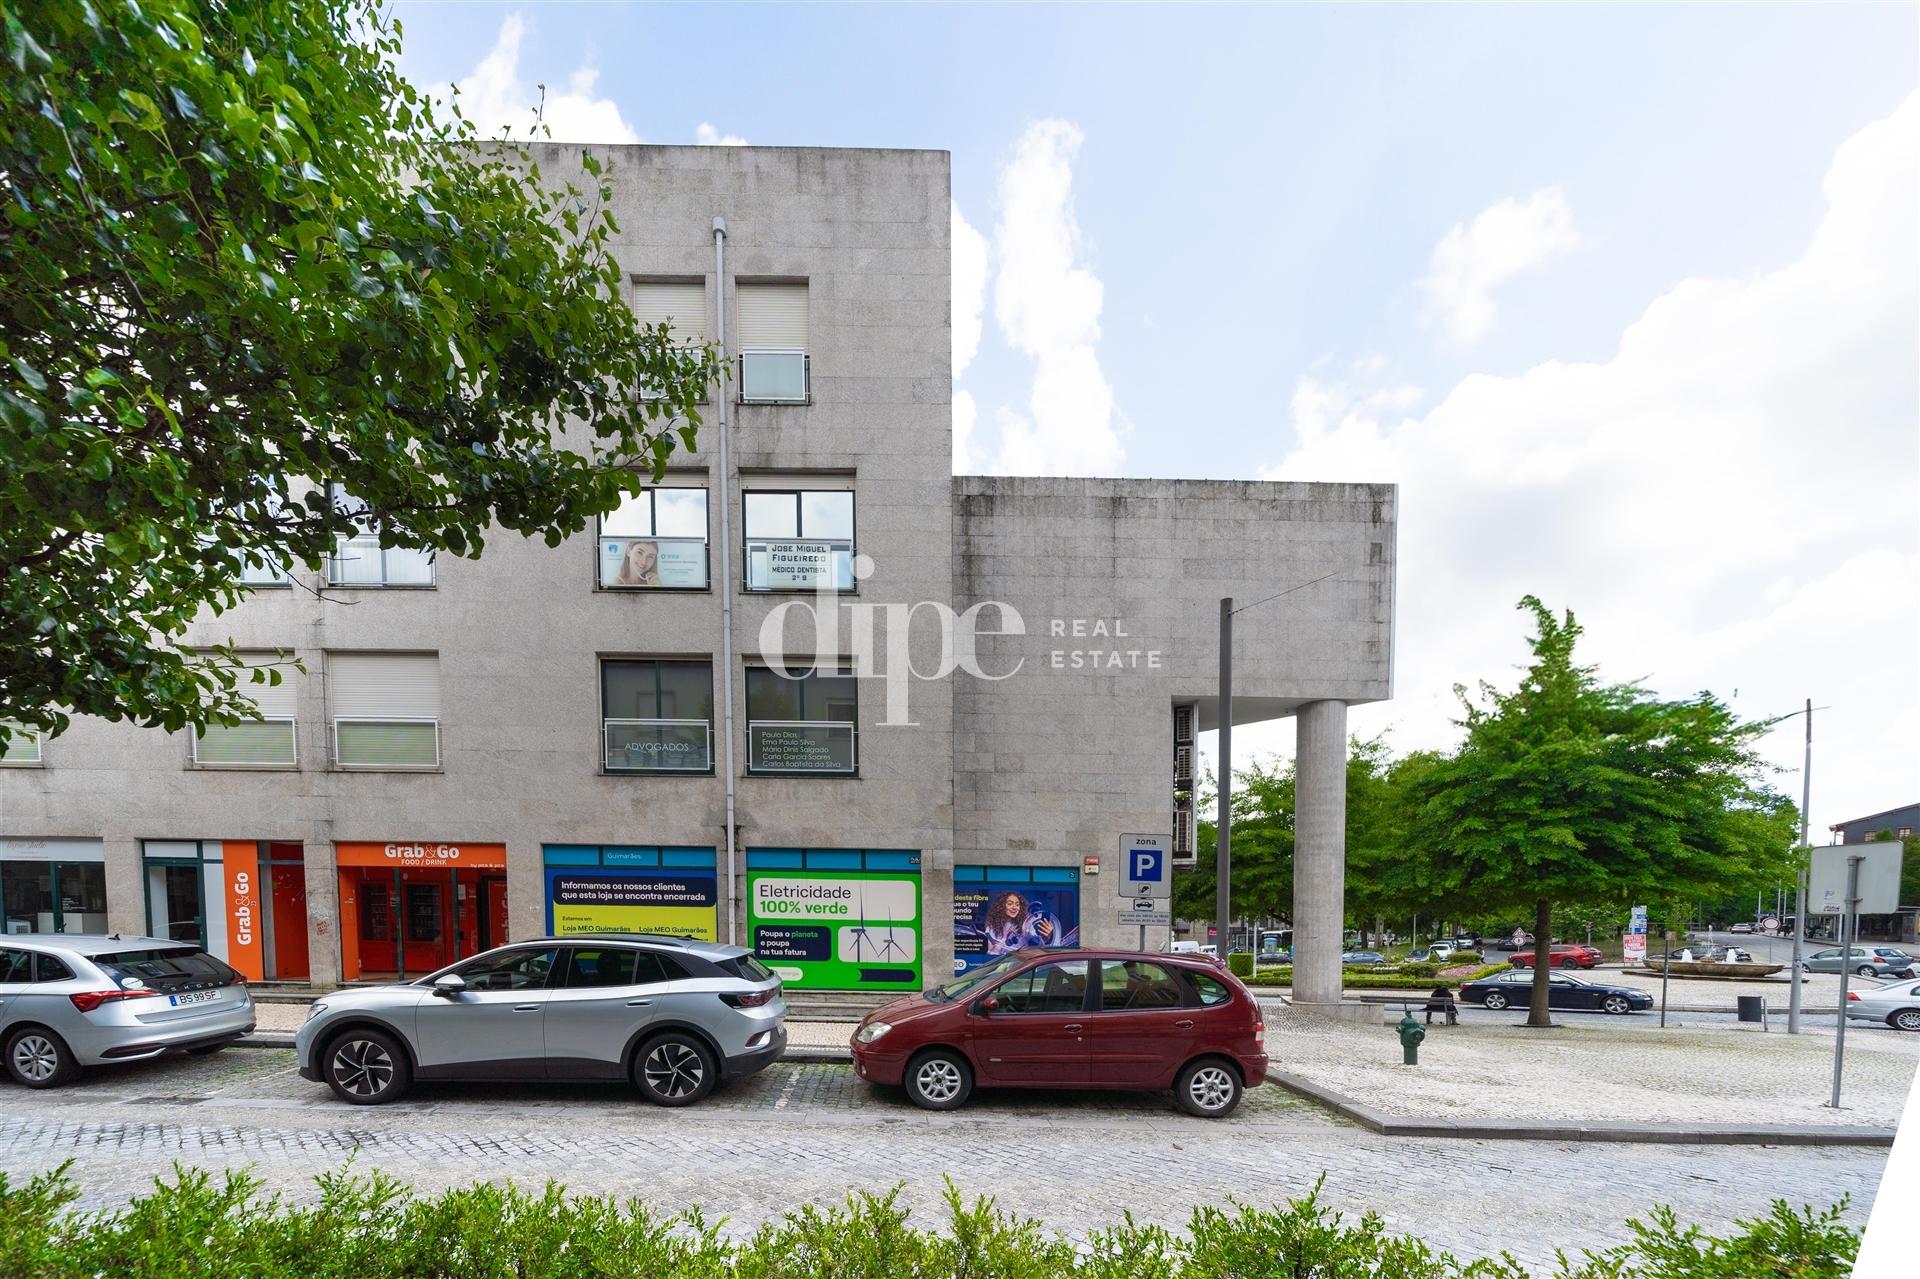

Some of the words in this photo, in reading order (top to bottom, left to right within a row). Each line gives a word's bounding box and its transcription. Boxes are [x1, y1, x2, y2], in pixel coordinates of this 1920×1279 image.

[772, 554, 826, 562] FIGUEIREDO
[799, 738, 816, 746] Silva
[624, 742, 689, 752] ADVOGADOS
[799, 746, 829, 754] Salgado
[785, 761, 813, 769] Baptista
[384, 844, 460, 859] Grab&Go
[1136, 854, 1155, 877] P
[561, 881, 611, 890] Informamos
[623, 883, 652, 891] nossos
[653, 882, 686, 891] clientes
[760, 884, 851, 899] Eletricidade
[561, 893, 577, 901] que
[579, 892, 597, 900] esta
[598, 892, 613, 902] loja
[664, 893, 706, 901] encerrada
[234, 872, 252, 945] Grab&Go
[760, 901, 801, 914] 100%
[805, 902, 849, 914] verde
[562, 925, 577, 933] Loja
[671, 926, 708, 934] Guimarães
[760, 930, 784, 939] Poupa
[791, 930, 819, 939] planeta
[766, 940, 790, 949] poupa
[784, 948, 807, 956] fatura
[180, 994, 194, 1004] BS
[195, 993, 205, 1001] 99
[205, 990, 217, 1000] SF
